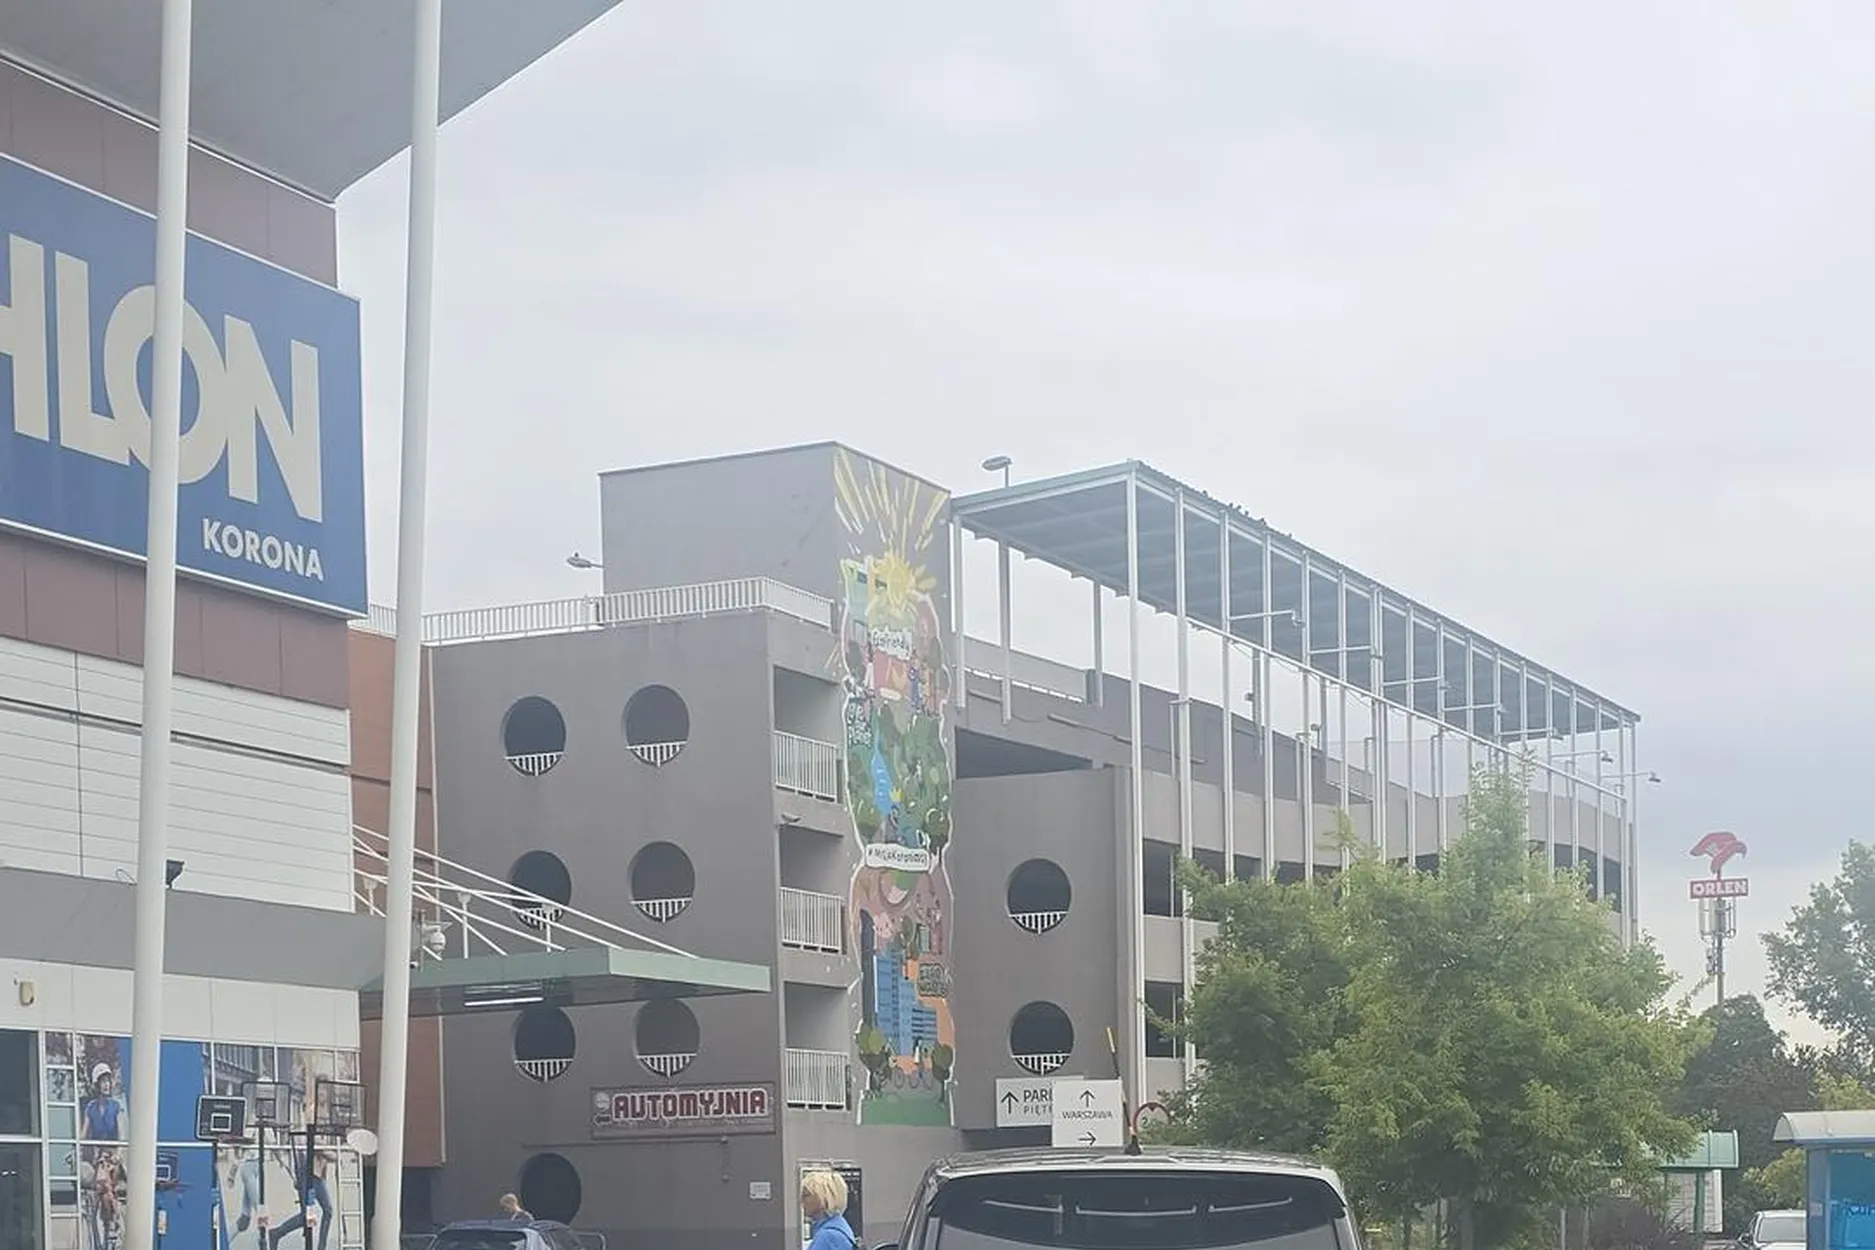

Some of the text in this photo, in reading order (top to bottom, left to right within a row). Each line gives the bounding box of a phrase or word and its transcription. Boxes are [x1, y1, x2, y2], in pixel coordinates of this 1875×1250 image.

[202, 517, 324, 581] KORONA
[1692, 881, 1747, 896] ORLEN
[612, 1088, 768, 1121] AUTOMYJNIA
[1062, 1110, 1113, 1120] WARSZAWA
